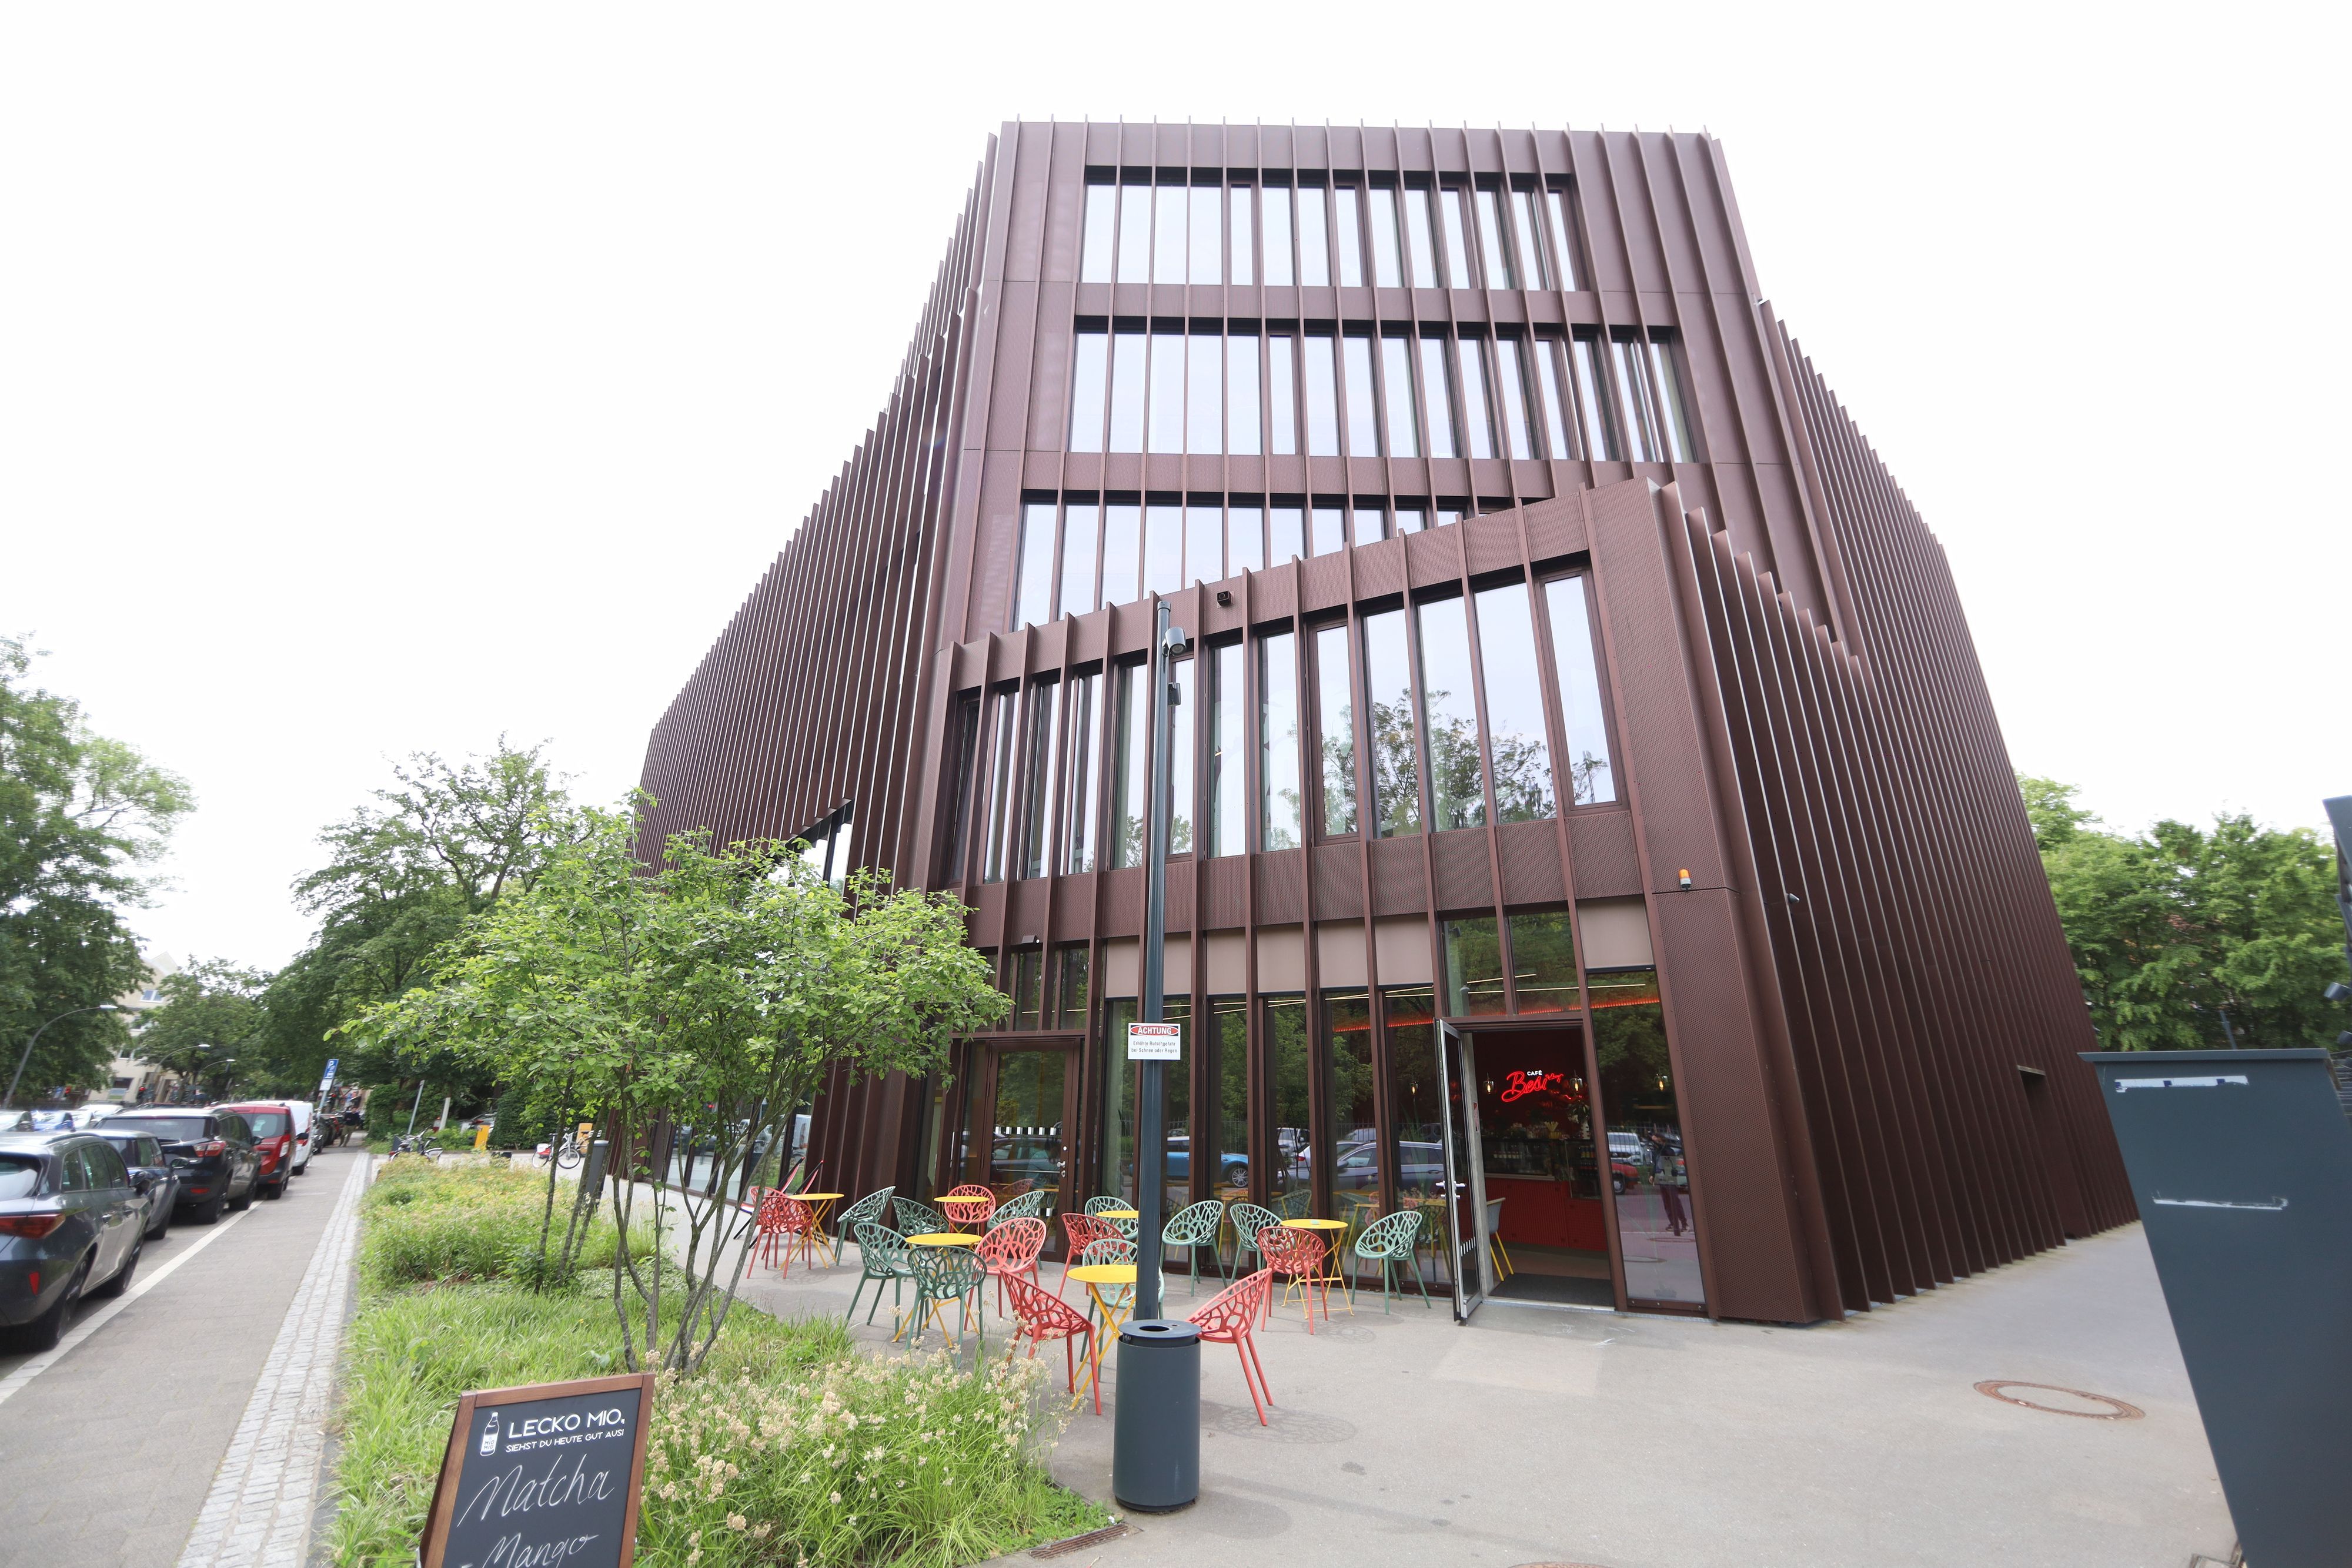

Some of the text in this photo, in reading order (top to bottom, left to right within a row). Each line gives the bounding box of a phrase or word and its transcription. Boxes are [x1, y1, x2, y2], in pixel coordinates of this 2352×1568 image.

[1137, 1027, 1172, 1035] ACHTUNG
[509, 1409, 625, 1439] LECKO MIO,
[506, 1442, 537, 1453] SIEHST
[539, 1439, 552, 1448] DU
[554, 1435, 583, 1446] HEUTE
[585, 1432, 603, 1441] GUT
[457, 1453, 615, 1528] Matcha
